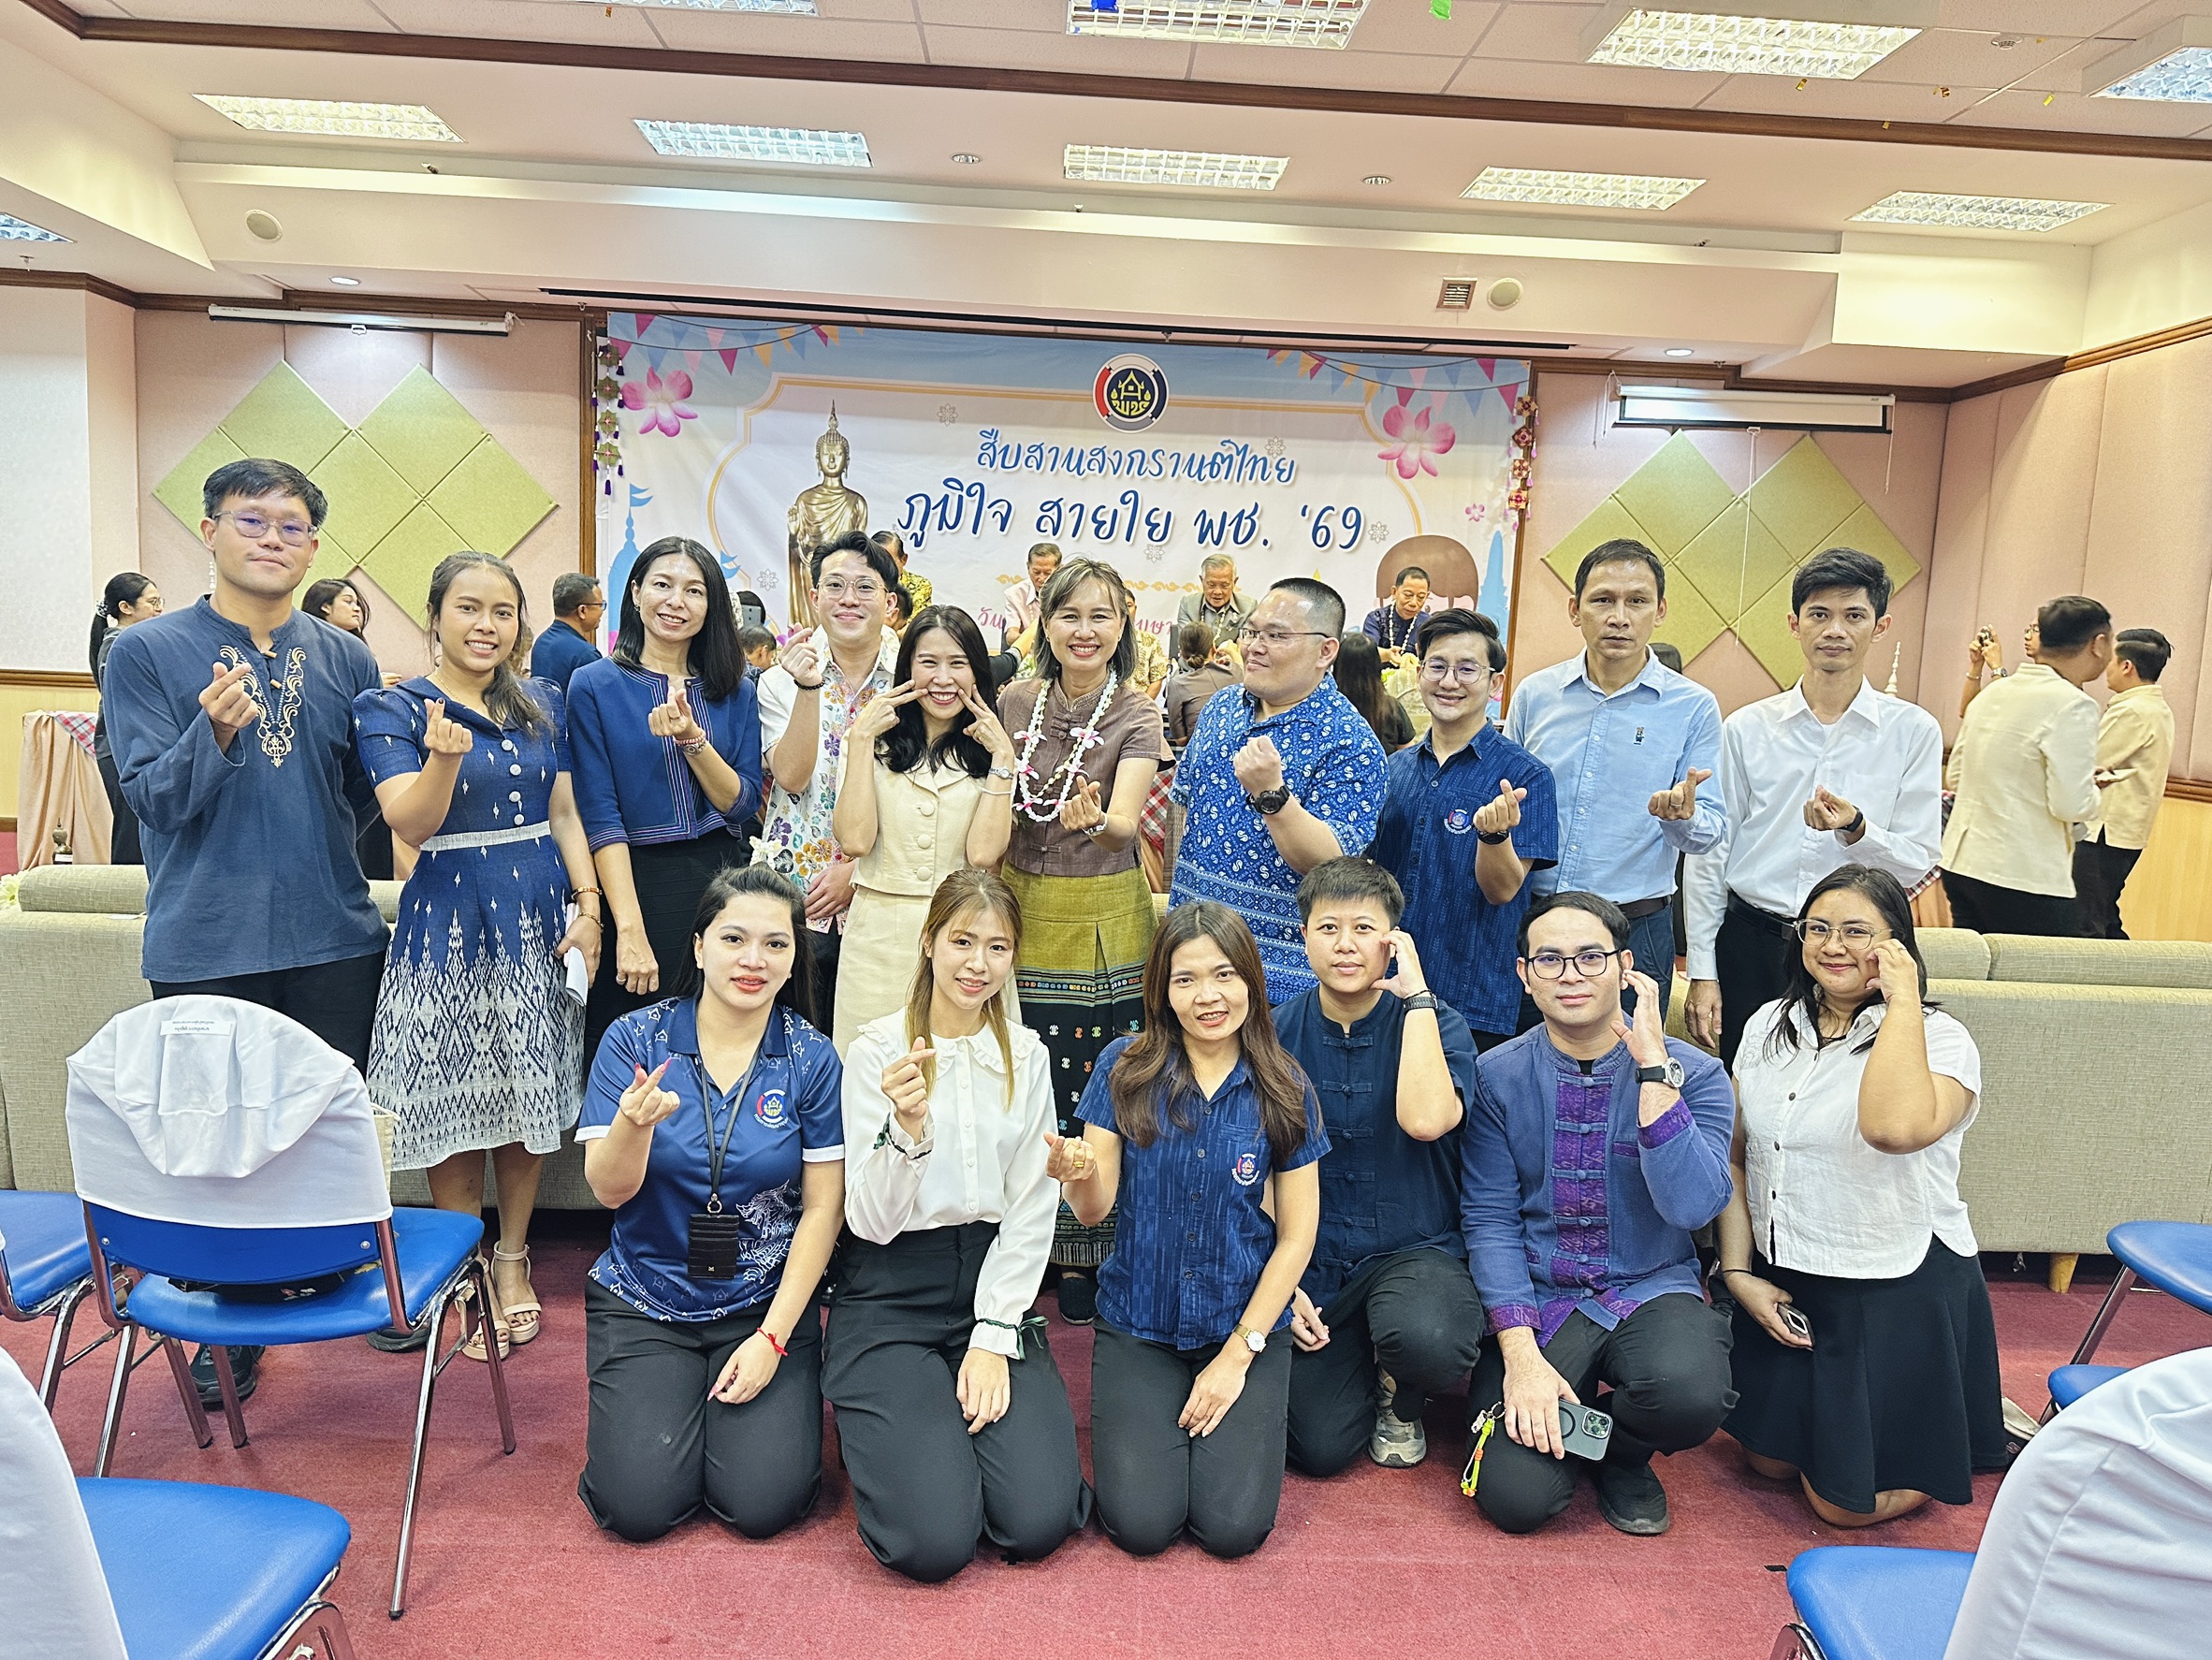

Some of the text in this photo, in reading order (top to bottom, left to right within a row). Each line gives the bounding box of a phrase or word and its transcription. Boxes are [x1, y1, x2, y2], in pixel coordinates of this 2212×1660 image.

[977, 428, 1295, 483] สืบสานสงกรานต์ไทย
[897, 477, 1012, 548] ภูมิใจ
[1036, 489, 1172, 543] สายใย
[1193, 502, 1270, 546] พช.
